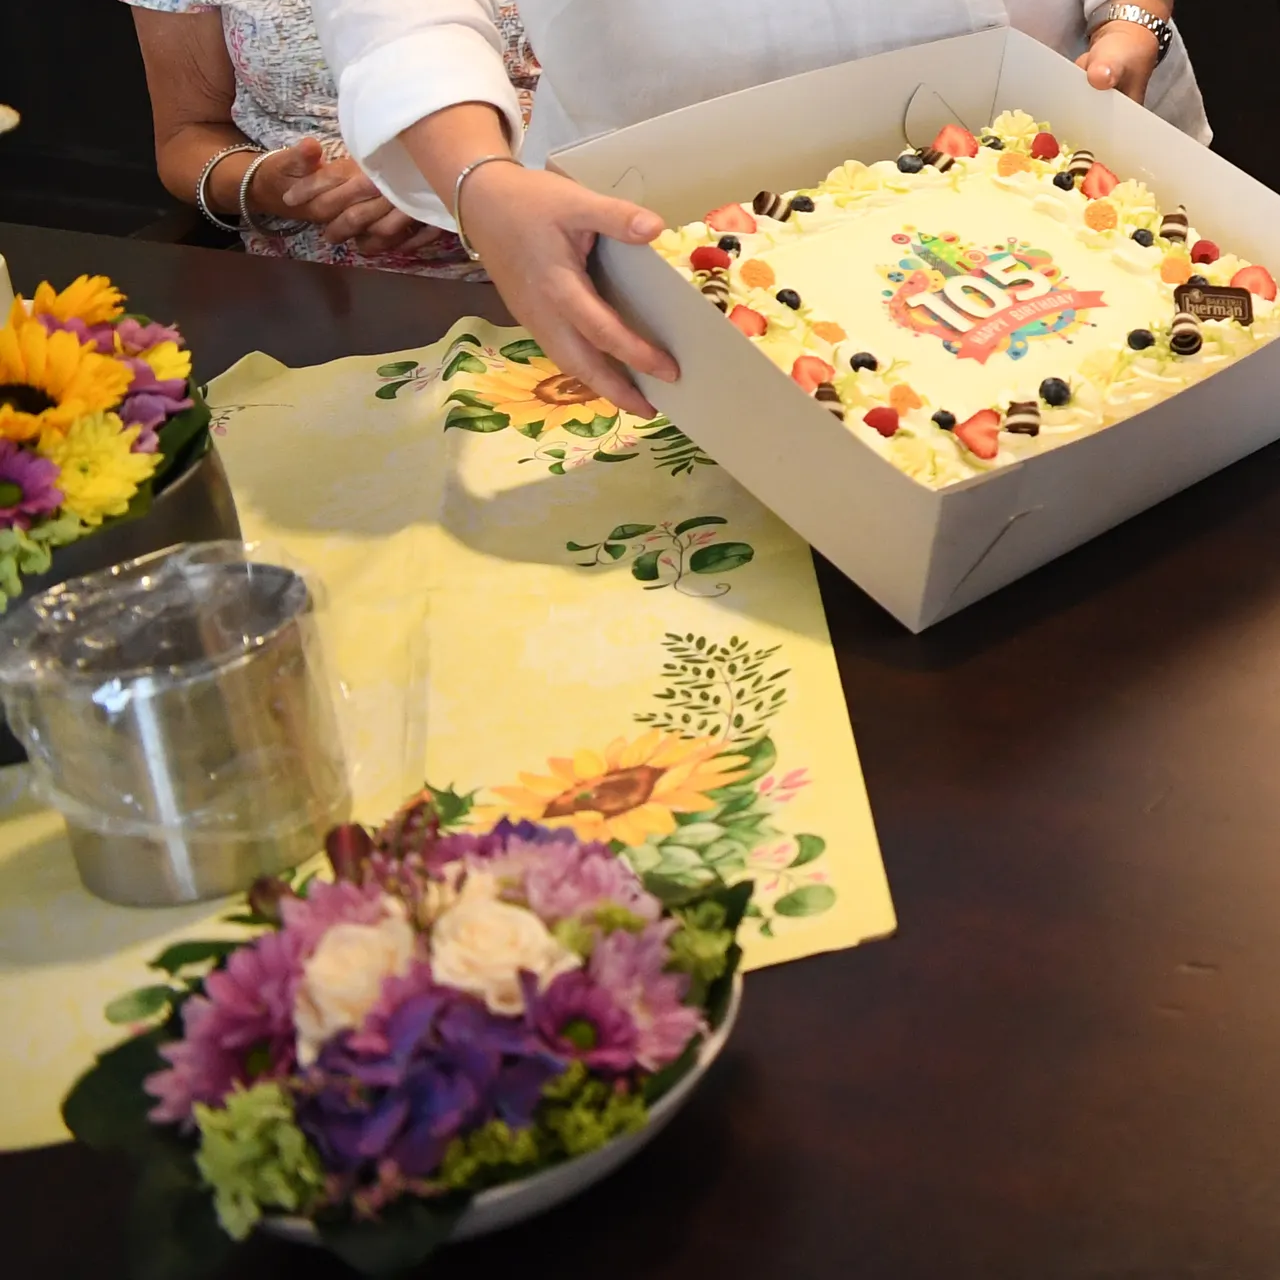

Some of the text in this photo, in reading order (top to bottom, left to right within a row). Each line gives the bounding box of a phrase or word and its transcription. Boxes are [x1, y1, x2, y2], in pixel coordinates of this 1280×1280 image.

[905, 255, 1052, 333] 105
[969, 292, 1075, 346] HAPPY BIRTHDAY
[1185, 296, 1243, 317] bierman
